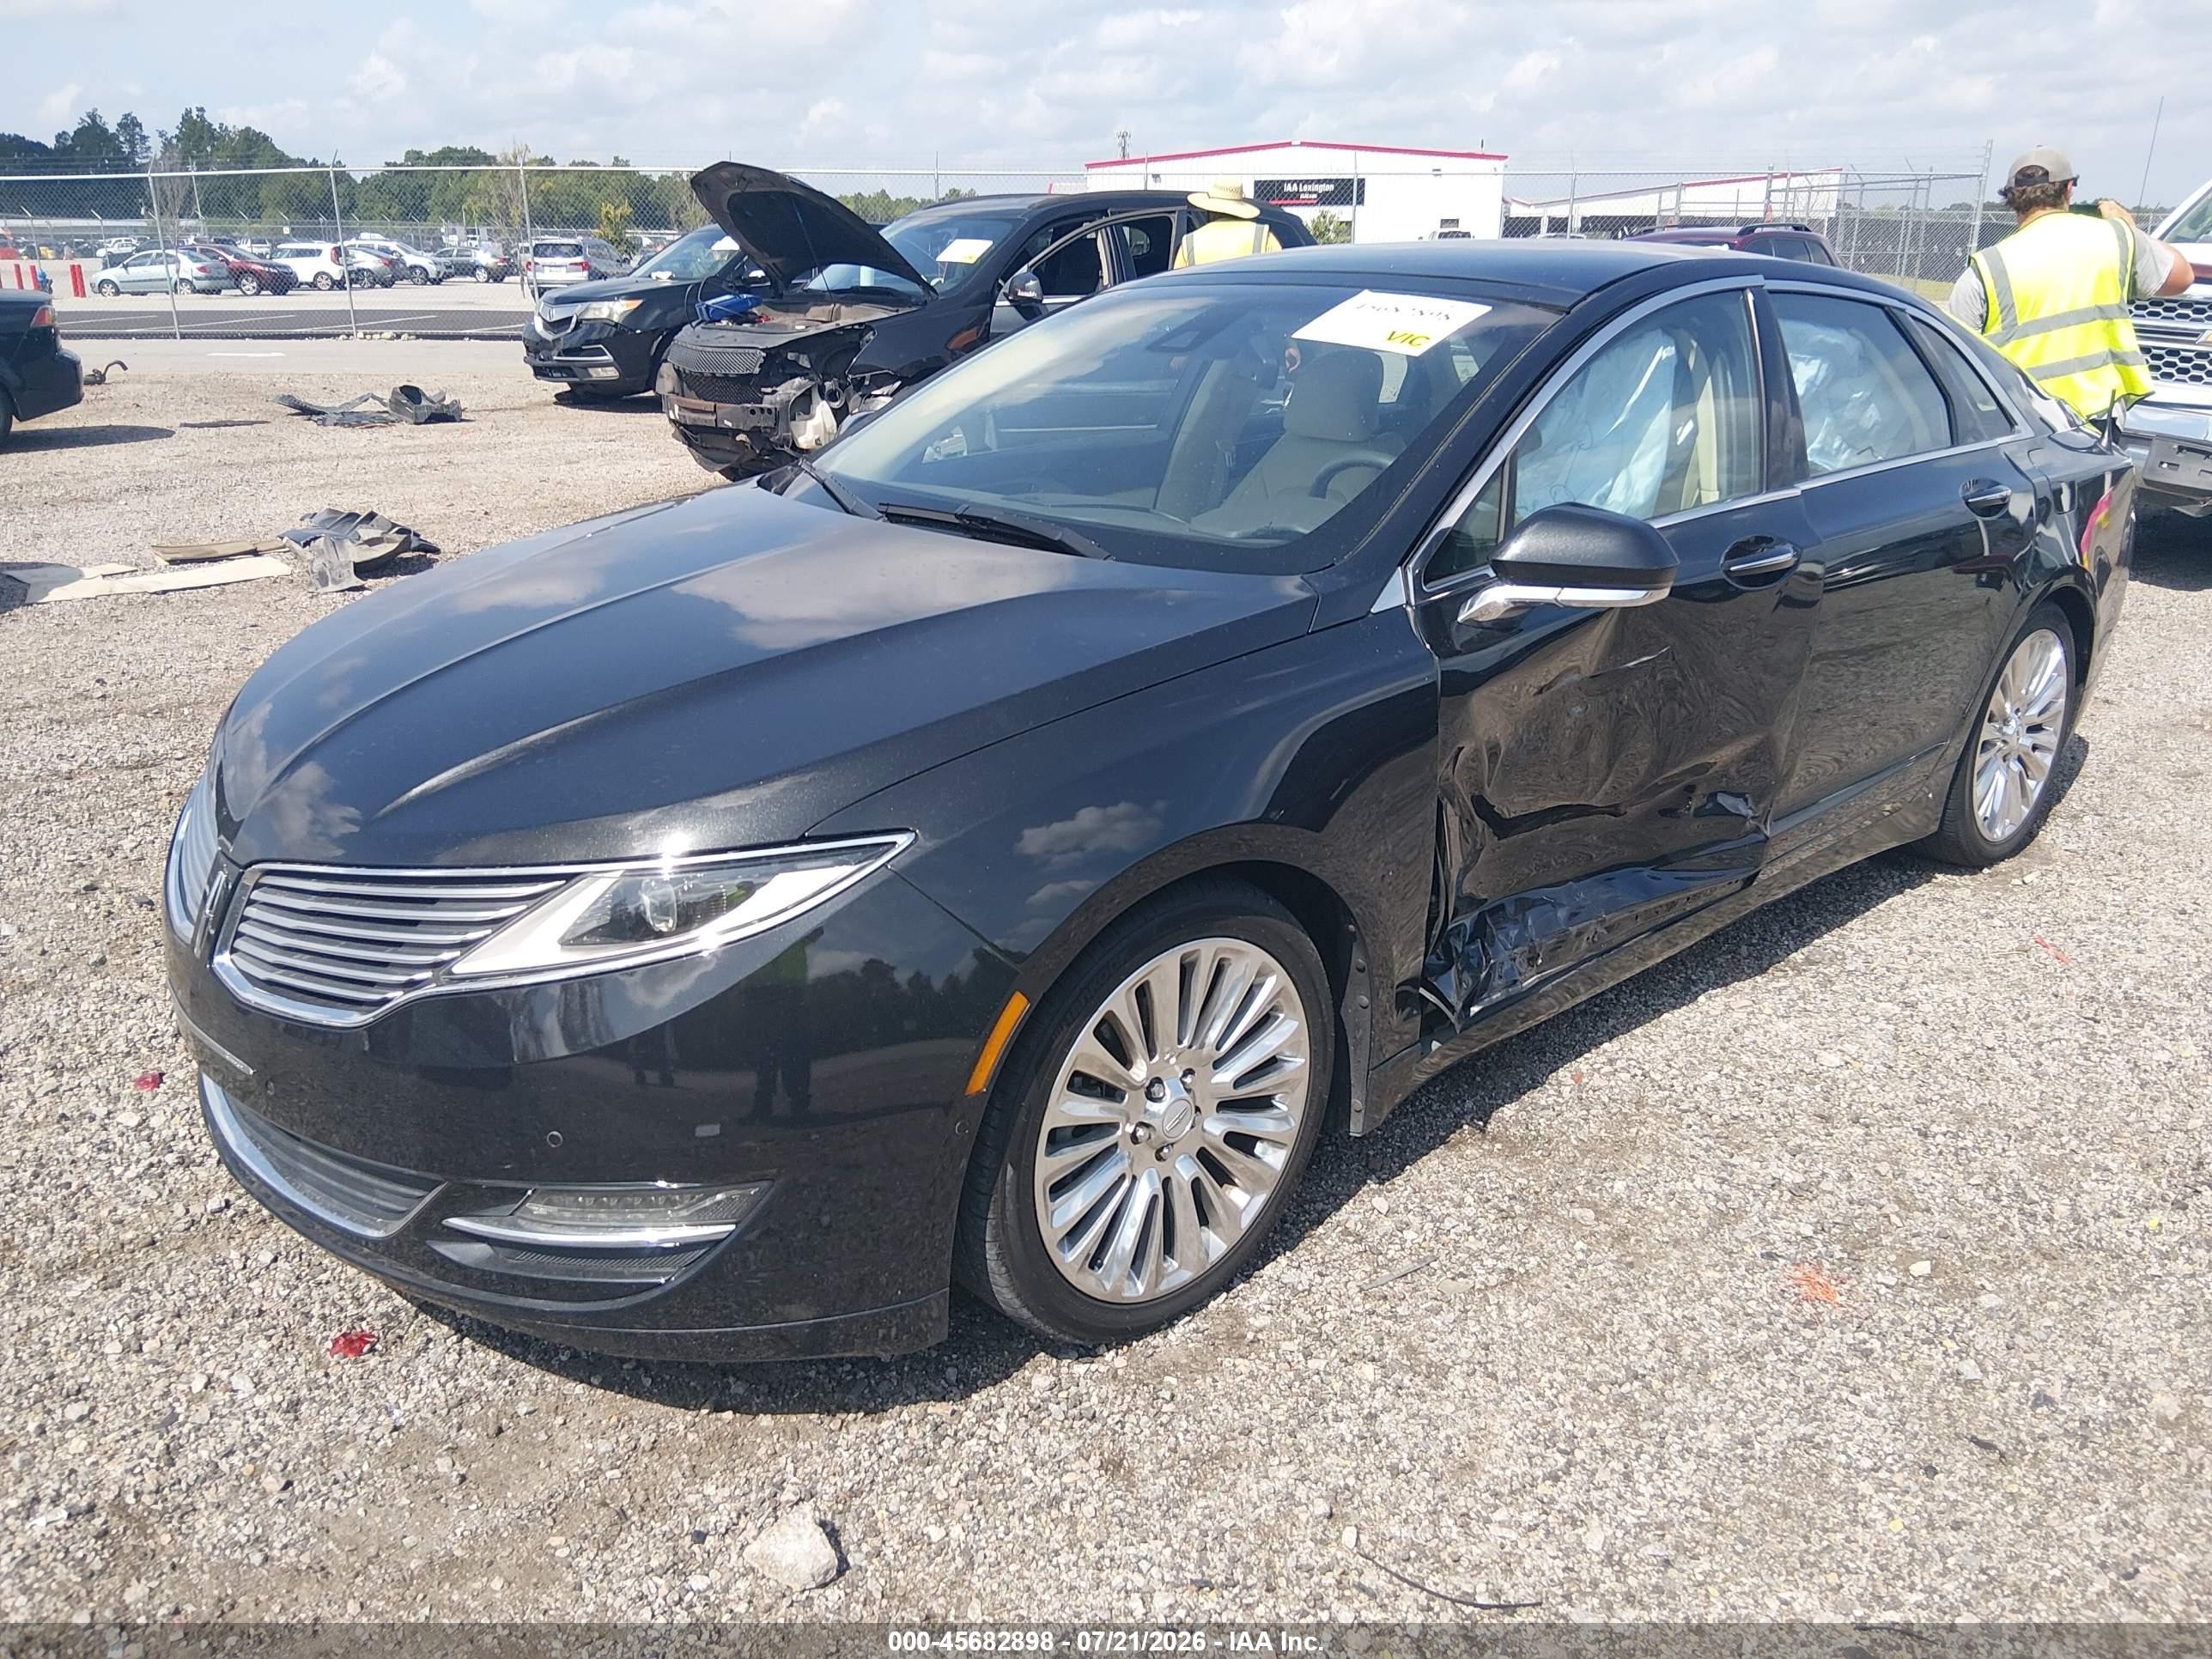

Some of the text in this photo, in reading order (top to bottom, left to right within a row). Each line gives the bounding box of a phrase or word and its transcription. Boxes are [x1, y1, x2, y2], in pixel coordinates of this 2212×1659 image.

[1284, 182, 1334, 193] IAA Lexington
[1387, 331, 1431, 346] VIC
